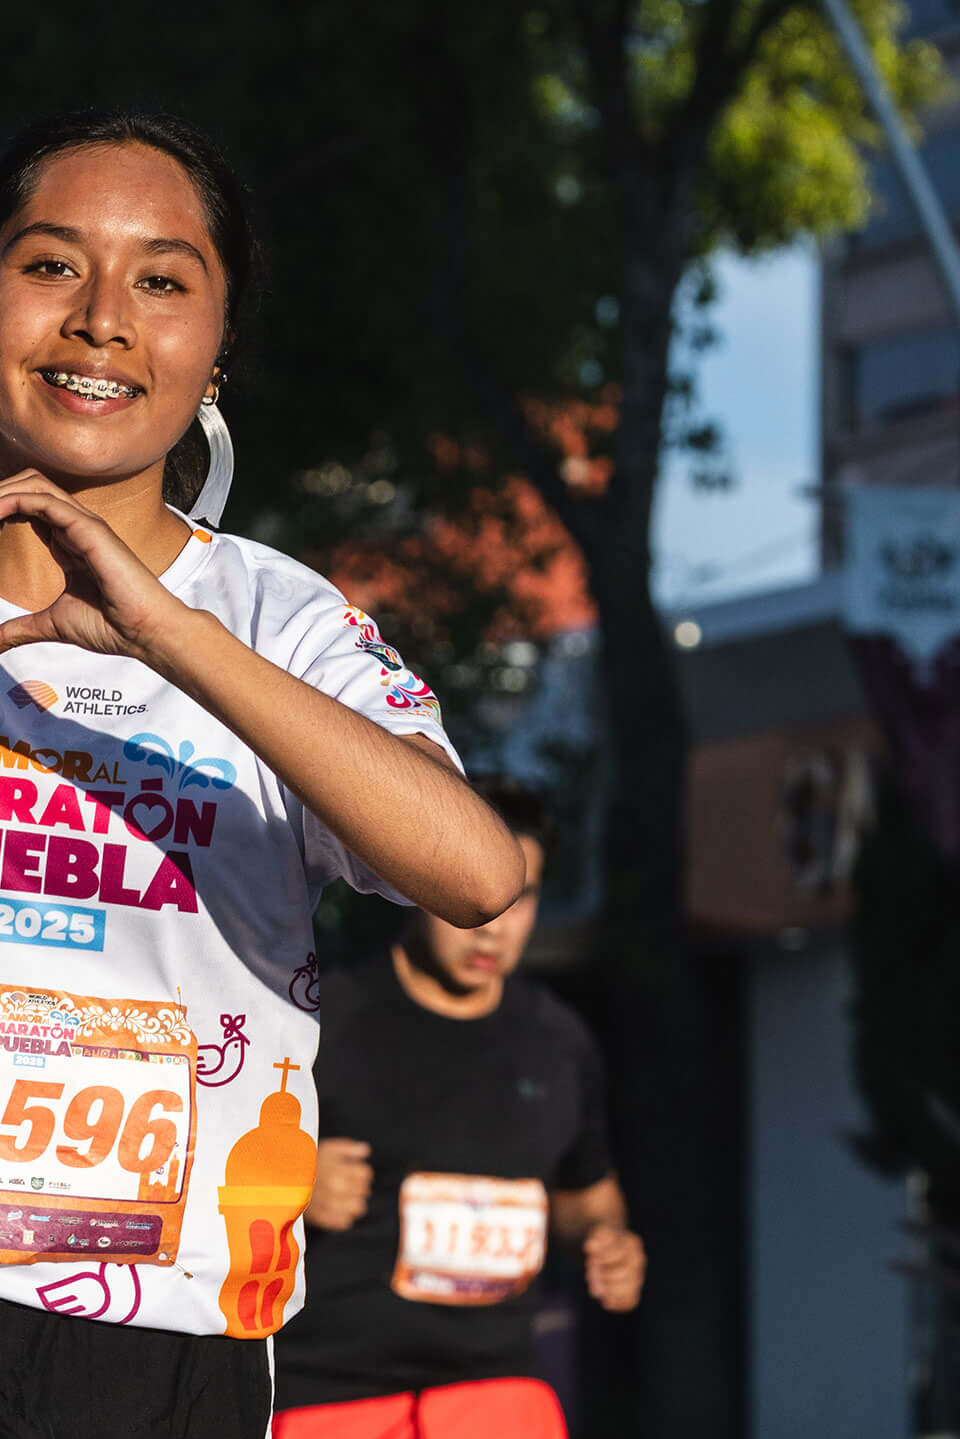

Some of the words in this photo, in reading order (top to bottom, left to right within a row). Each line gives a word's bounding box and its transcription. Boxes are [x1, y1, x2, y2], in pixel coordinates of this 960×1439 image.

[66, 686, 122, 702] WORLD
[63, 702, 147, 716] ATHLETICS
[94, 761, 128, 785] AL
